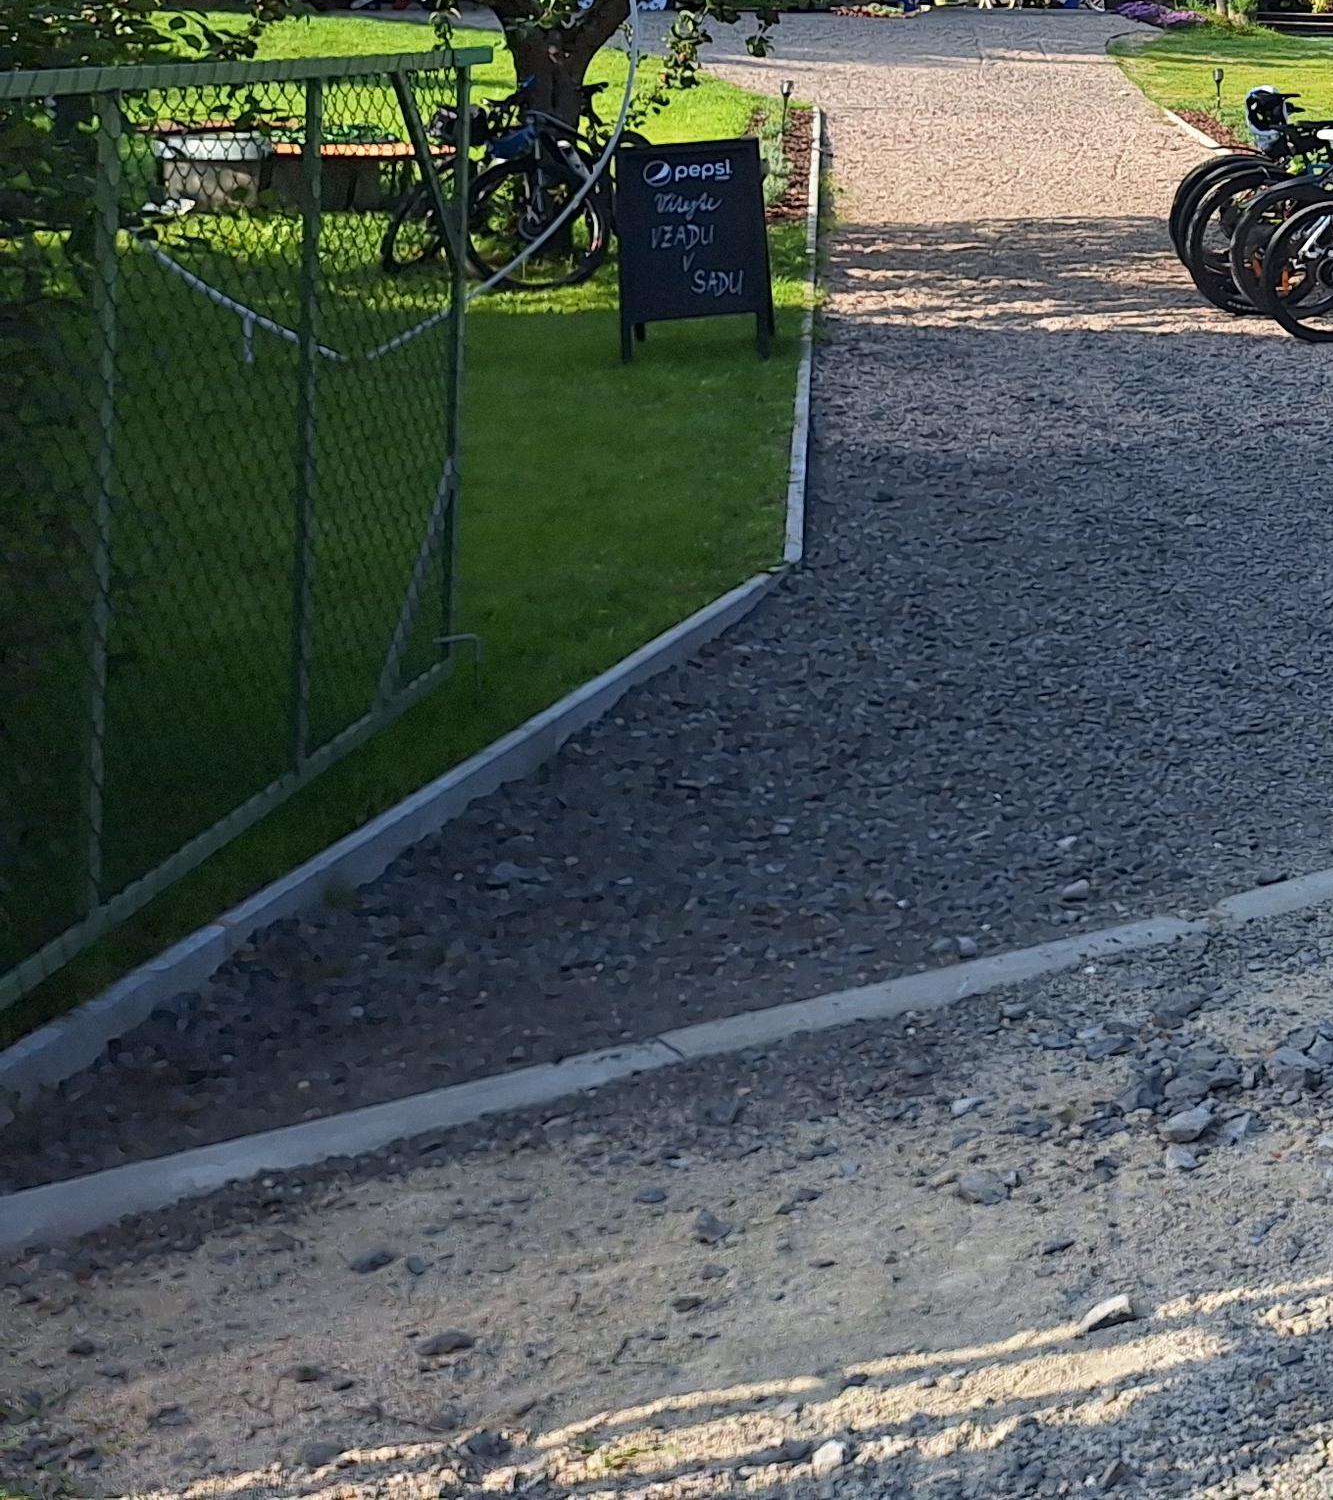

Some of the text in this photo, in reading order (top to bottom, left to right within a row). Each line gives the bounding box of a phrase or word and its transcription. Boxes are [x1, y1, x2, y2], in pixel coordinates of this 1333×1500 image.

[675, 159, 730, 182] pepsi
[651, 224, 714, 251] VZADU
[691, 269, 744, 297] SADU
